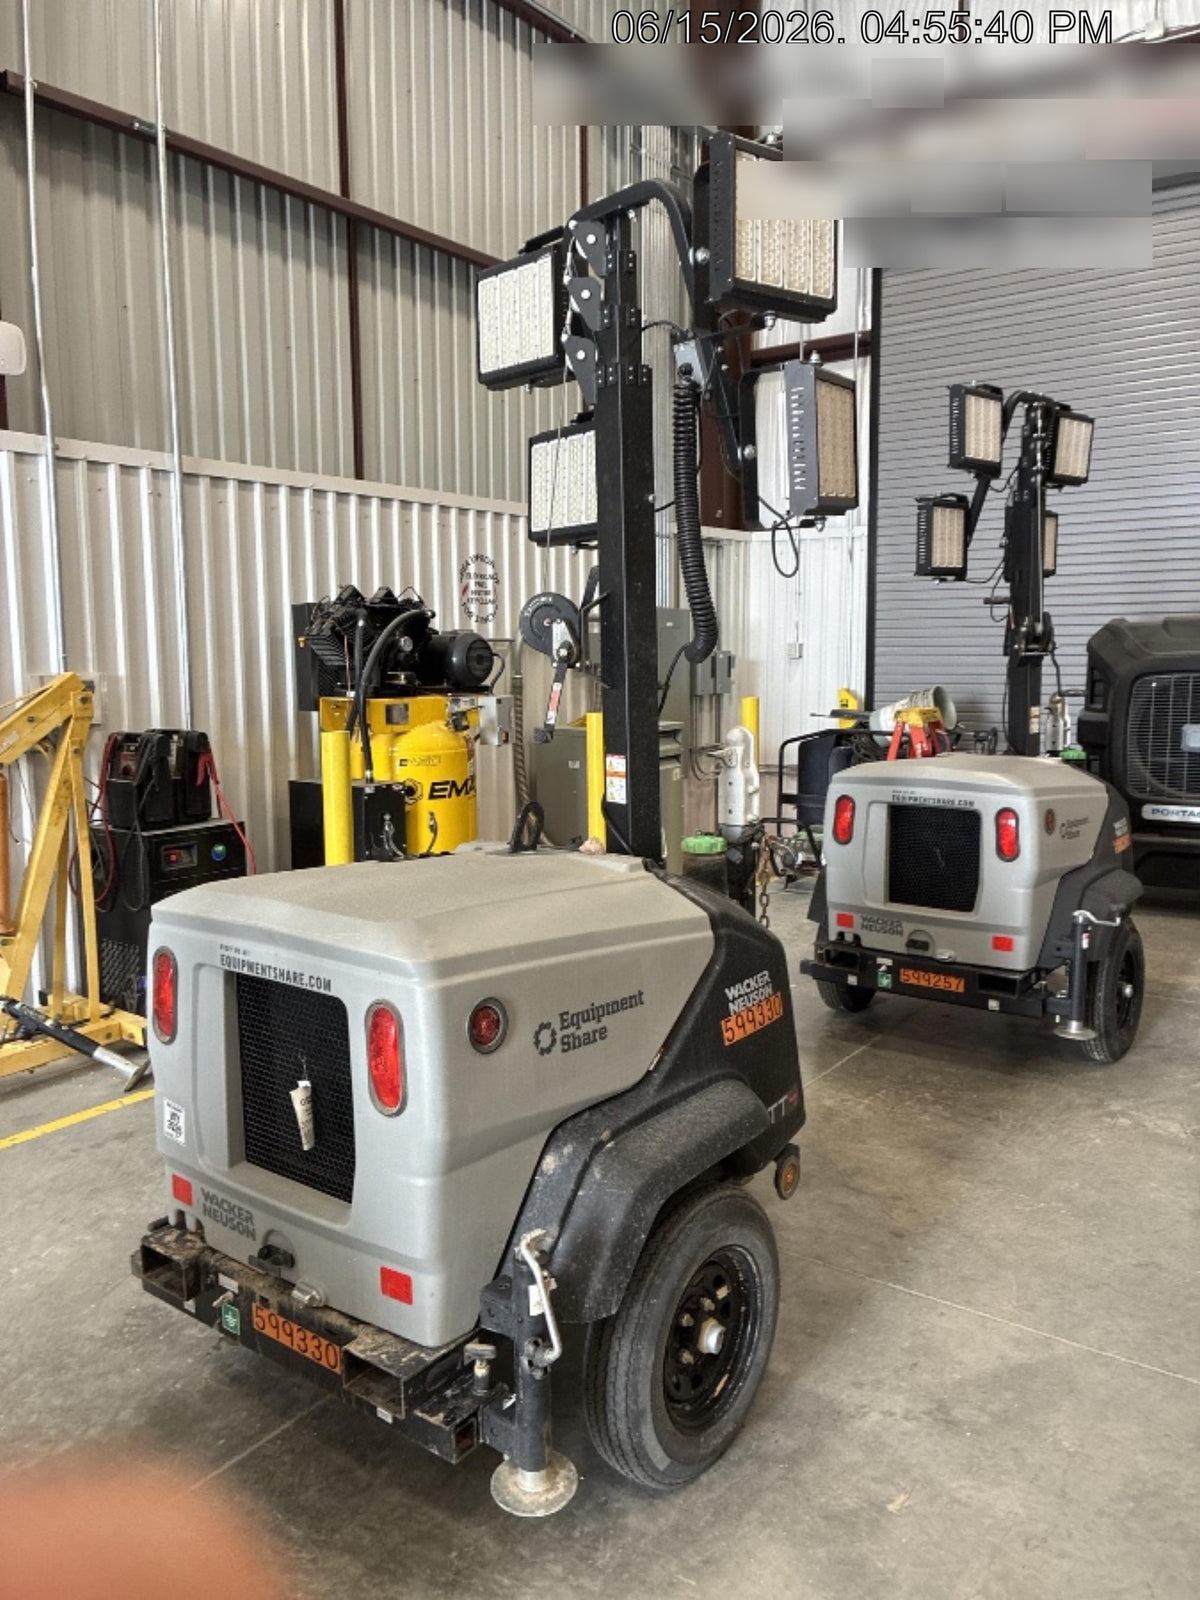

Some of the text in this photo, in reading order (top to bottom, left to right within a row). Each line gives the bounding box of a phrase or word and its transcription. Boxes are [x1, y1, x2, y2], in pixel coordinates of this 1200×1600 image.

[220, 954, 331, 992] EQUIPMENTSHARE.COM
[724, 970, 771, 1000] WACKER
[901, 970, 963, 990] 599257
[558, 989, 645, 1031] Equipment
[728, 983, 774, 1016] NEUSON
[723, 994, 783, 1044] 599330
[560, 1025, 608, 1053] Share
[201, 1187, 254, 1225] WACKER
[203, 1203, 257, 1241] NEUSON
[254, 1303, 339, 1371] 599330
